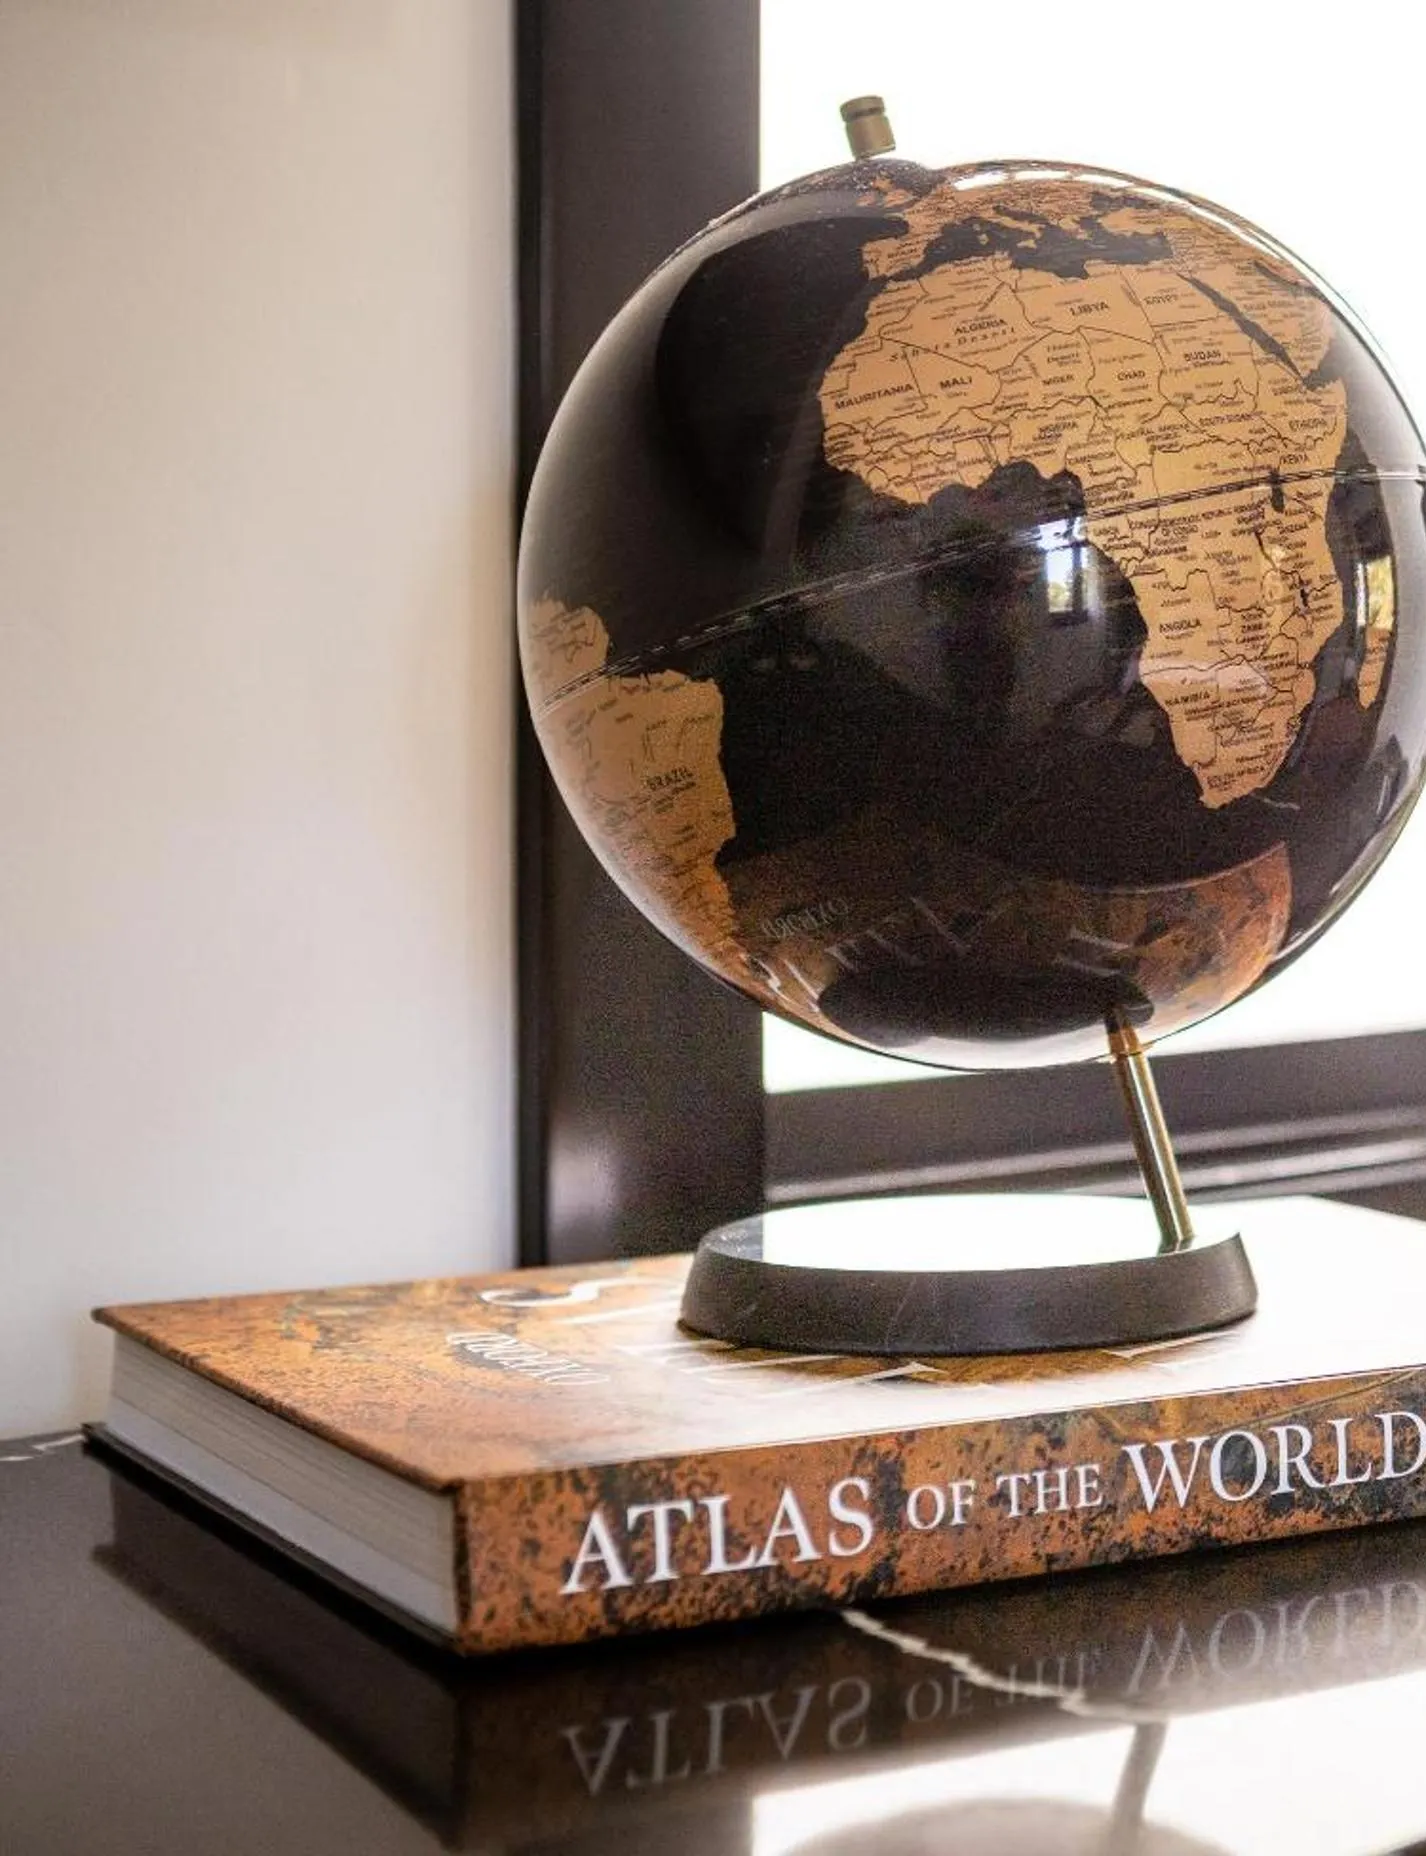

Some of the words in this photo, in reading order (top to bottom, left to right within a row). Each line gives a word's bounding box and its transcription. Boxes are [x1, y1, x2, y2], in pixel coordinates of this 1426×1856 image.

[1069, 301, 1109, 316] LIBYA
[954, 318, 1007, 335] ALGERIA
[940, 376, 972, 390] MALI
[1117, 369, 1145, 381] CHAD
[834, 383, 914, 410] MAURITANIA
[1159, 617, 1202, 634] ANGOLA
[646, 766, 694, 791] BRAZIL
[559, 1475, 875, 1596] ATLAS
[906, 1479, 976, 1531] OF
[995, 1463, 1103, 1519] THE
